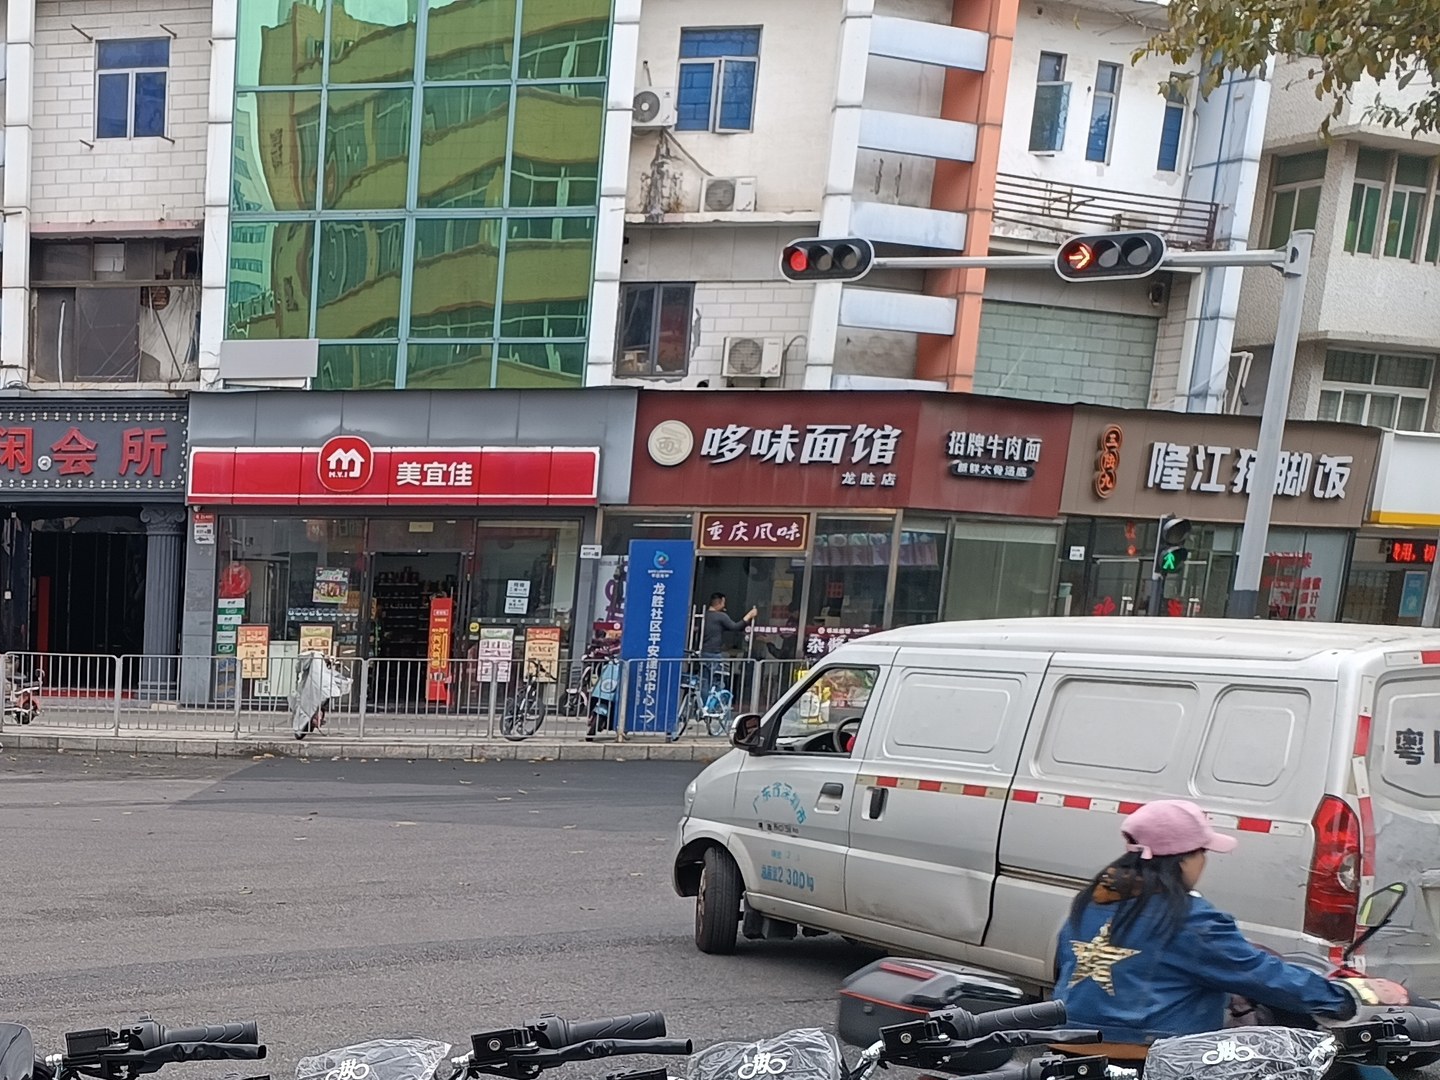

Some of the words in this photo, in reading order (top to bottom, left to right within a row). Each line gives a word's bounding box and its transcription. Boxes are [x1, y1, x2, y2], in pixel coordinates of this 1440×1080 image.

[700, 424, 902, 466] 哆味面馆
[948, 431, 1043, 462] 招牌牛肉面
[396, 461, 473, 487] 美宜佳
[841, 471, 896, 487] 龙胜店
[1393, 727, 1440, 765] 粤
